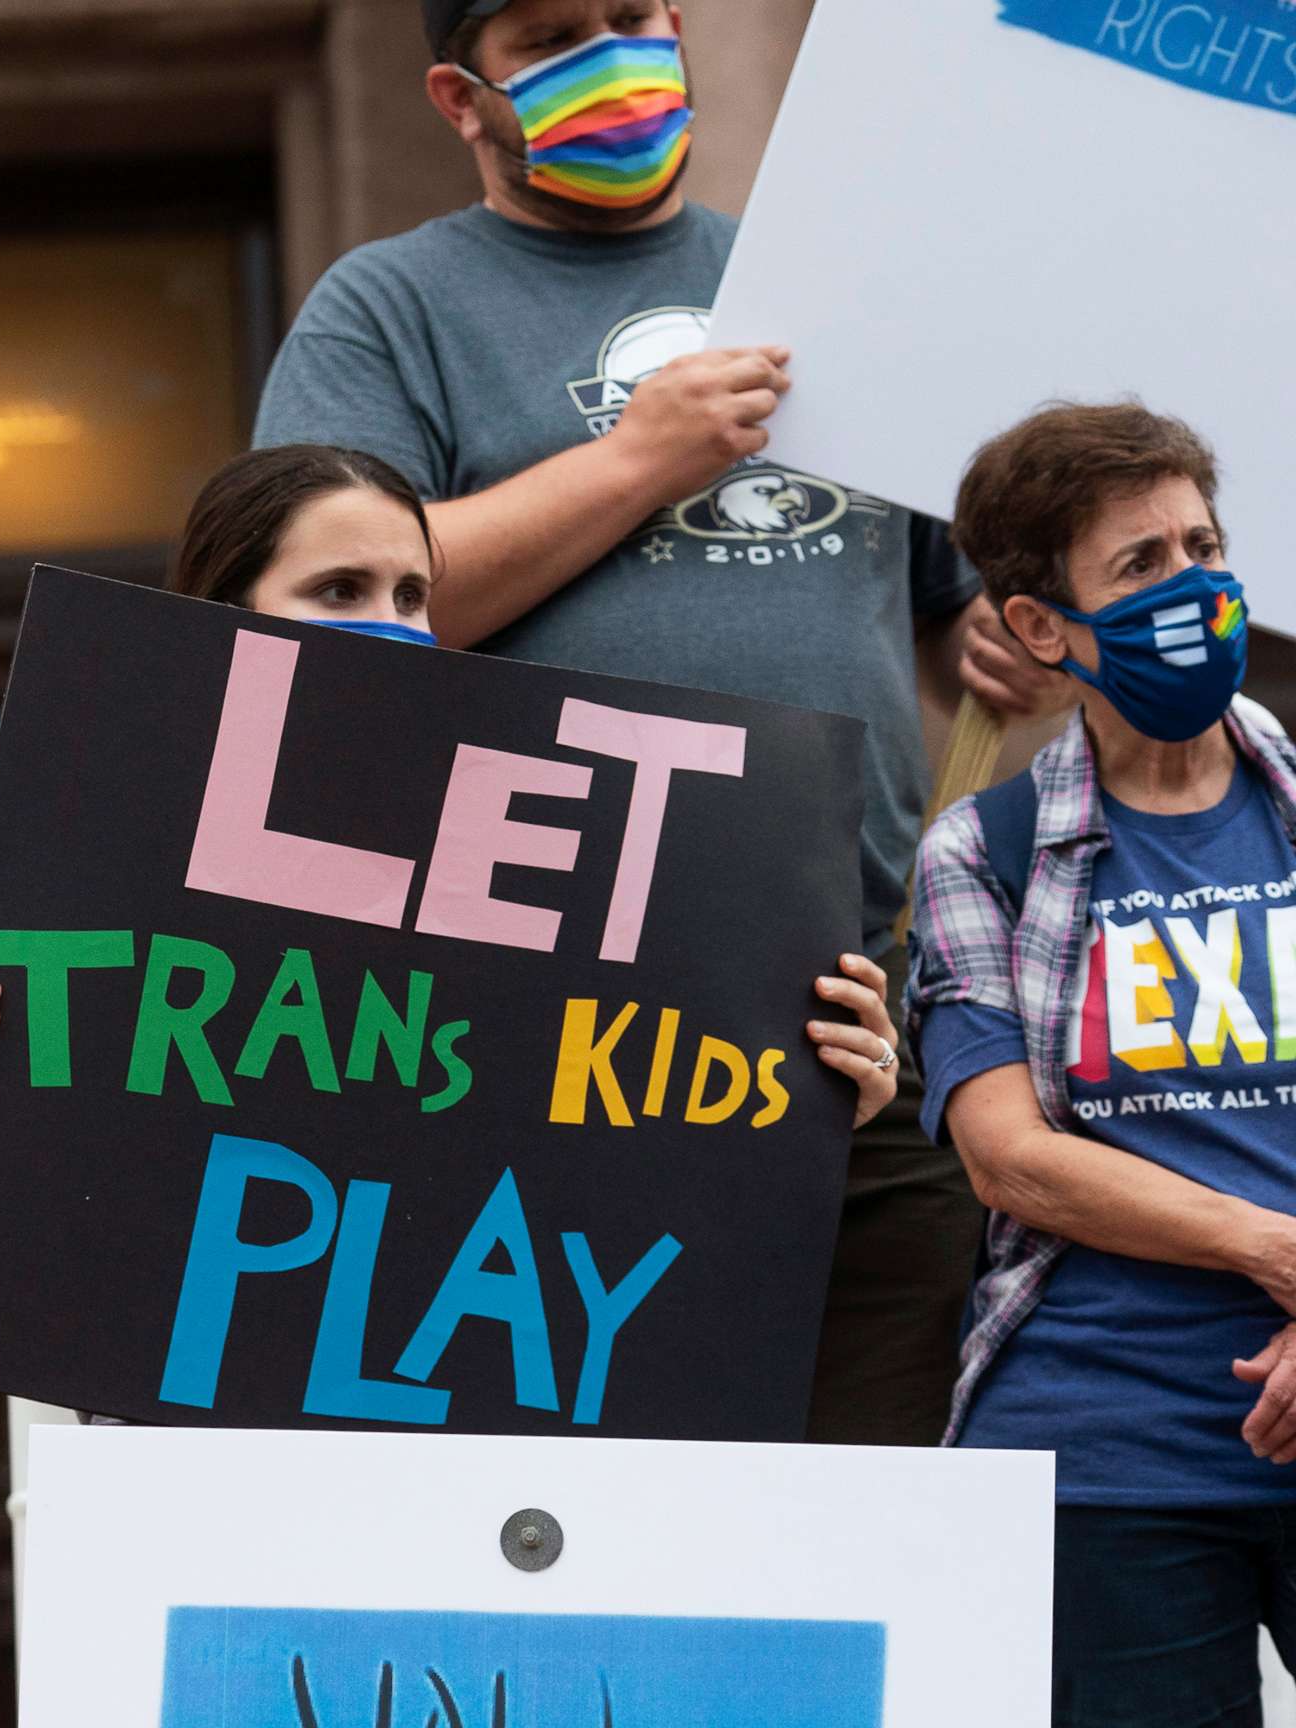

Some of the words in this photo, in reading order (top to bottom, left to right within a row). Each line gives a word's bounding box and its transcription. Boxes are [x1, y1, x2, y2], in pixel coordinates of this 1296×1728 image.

[1095, 0, 1296, 105] RIGHTS
[184, 628, 747, 964] LET
[1093, 898, 1117, 917] IF
[1119, 889, 1166, 913] YOU
[1170, 883, 1263, 911] ATTACK
[549, 997, 791, 1128] KIDS
[1073, 1098, 1113, 1120] OU
[1119, 1091, 1216, 1116] ATTACK
[1220, 1086, 1271, 1110] ALL
[158, 1133, 684, 1425] PLAY
